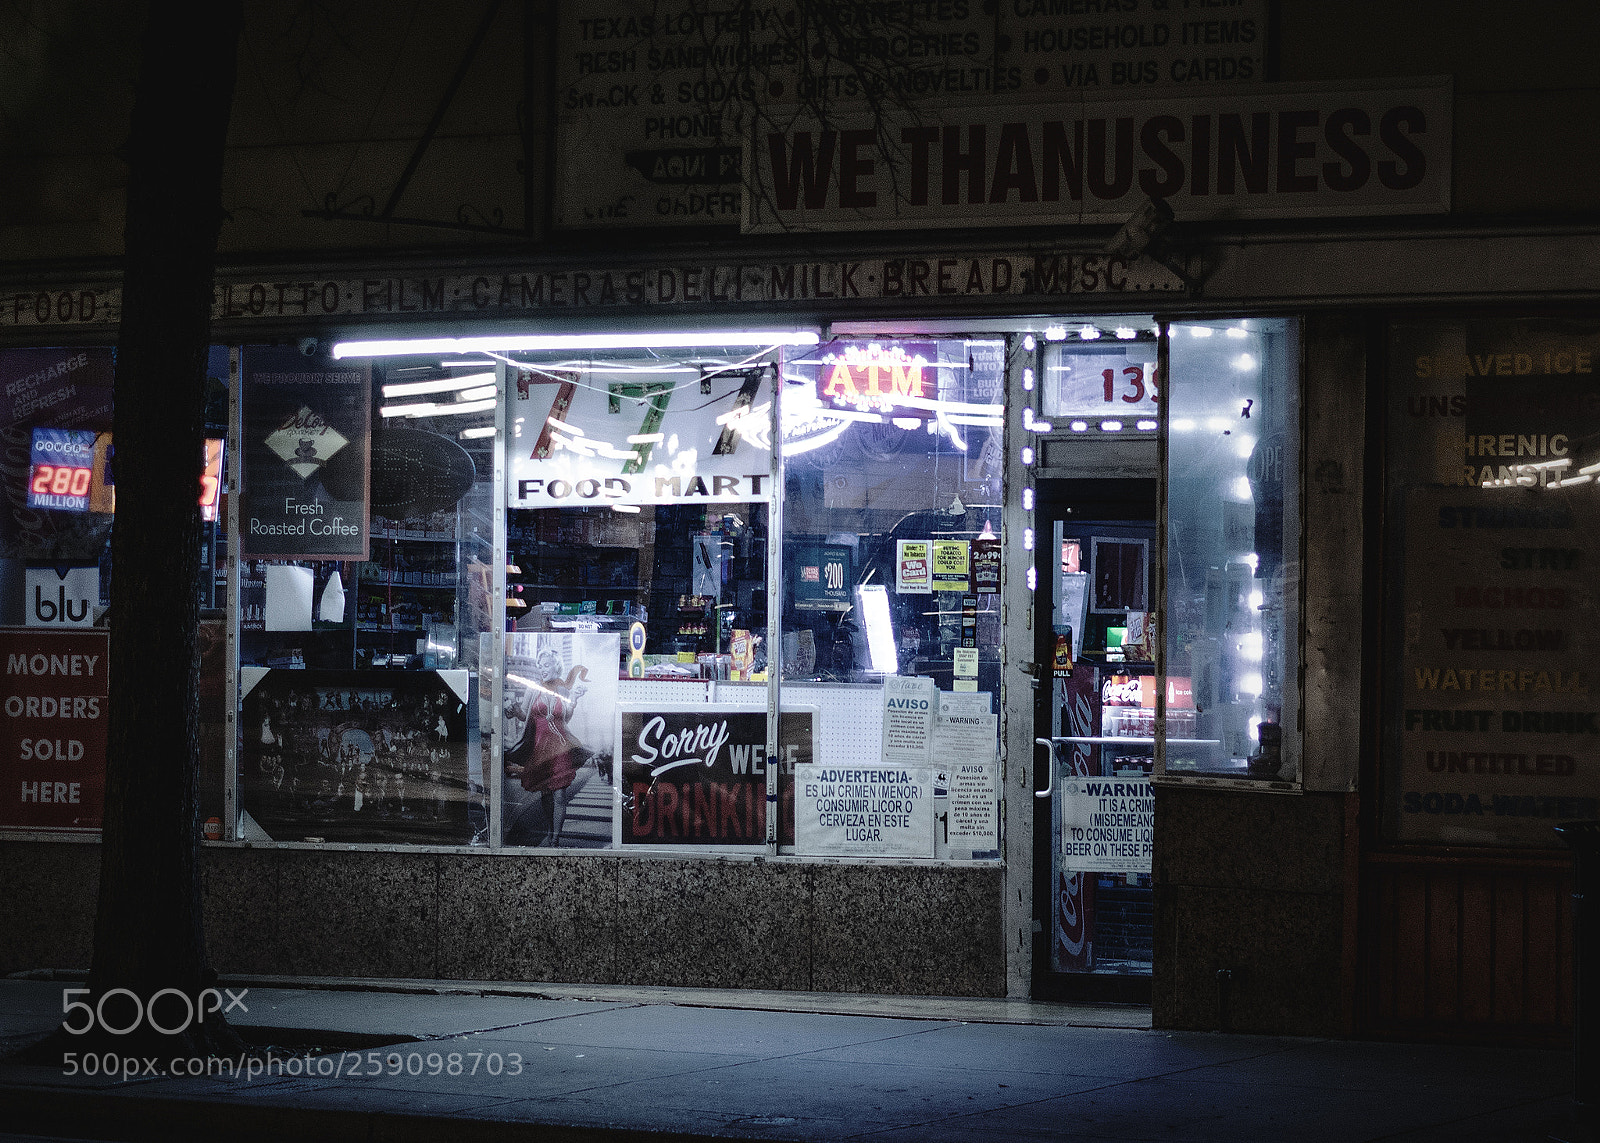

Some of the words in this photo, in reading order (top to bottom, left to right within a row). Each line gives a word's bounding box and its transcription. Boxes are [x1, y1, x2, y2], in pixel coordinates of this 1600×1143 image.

[578, 15, 656, 41] TEXAS
[665, 8, 772, 37] LOTTERY
[1023, 23, 1171, 53] HOUSEHOLD
[1180, 19, 1257, 45] ITEMS
[837, 31, 981, 61] GROCERIES
[575, 49, 636, 74] RESH
[648, 43, 798, 71] SANDWICHES
[796, 73, 859, 100] GIFTS
[895, 66, 1023, 95] NOVELTIES
[1062, 63, 1100, 87] VIA
[1111, 59, 1160, 86] BUS
[1170, 55, 1254, 83] CARDS
[650, 86, 666, 105] &
[678, 80, 757, 105] SODAS
[645, 113, 723, 139] PHONE
[651, 155, 707, 178] AQUI
[767, 128, 878, 211] WE
[14, 291, 97, 325] FOOD
[224, 280, 340, 317] LOTTO
[362, 278, 445, 312] FILM
[472, 269, 646, 310] CAMERAS
[657, 268, 743, 302] DELI
[770, 263, 860, 298] MILK
[882, 258, 1012, 297] BREAD
[5, 352, 89, 398] RECHARGE
[1415, 352, 1534, 378] SAVED
[1544, 350, 1593, 374] ICE
[324, 372, 361, 384] SERVE
[823, 362, 925, 397] ATM
[12, 384, 77, 421] REFRESH
[14, 389, 39, 407] AND
[35, 440, 82, 453] POWER
[1440, 433, 1570, 457] HRENIC
[33, 465, 92, 496] 280
[517, 478, 631, 500] FOOD
[654, 474, 770, 498] MART
[33, 493, 85, 509] MILLION
[284, 497, 324, 515] Fresh
[250, 517, 306, 536] Roasted
[309, 517, 359, 536] Coffee
[823, 562, 844, 590] $200
[902, 567, 927, 578] Card
[905, 560, 923, 570] We
[35, 585, 88, 622] blu
[1438, 628, 1565, 651] YELLOW
[6, 653, 99, 677] MONEY
[1053, 669, 1071, 677] PULL
[1414, 667, 1589, 694] WATERFALL
[4, 695, 101, 719] ORDERS
[887, 697, 929, 710] AVISO
[949, 717, 980, 725] WARNING
[1404, 708, 1494, 732] FRUIT
[19, 738, 85, 761] SOLD
[630, 715, 730, 768] Sorry
[728, 743, 800, 776] WERE
[961, 765, 984, 774] AVISO
[1425, 750, 1576, 777] UNTITLED
[21, 780, 81, 804] HERE
[805, 784, 819, 797] ES
[821, 784, 837, 798] UN
[837, 785, 876, 799] CRIMEN
[877, 786, 923, 800] (MENOR)
[816, 799, 870, 813] CONSUMIR
[872, 800, 902, 813] LICOR
[904, 801, 914, 813] O
[1098, 799, 1108, 812] IT
[1109, 799, 1118, 812] IS
[1119, 799, 1128, 812] A
[819, 813, 866, 827] CERVEZA
[868, 814, 882, 827] EN
[884, 814, 910, 828] ESTE
[846, 828, 883, 842] LUGAR.
[1070, 827, 1084, 841] TO
[1086, 828, 1133, 842] CONSUME
[1066, 842, 1092, 856] BEER
[1093, 843, 1108, 856] ON
[1109, 843, 1140, 857] THESE
